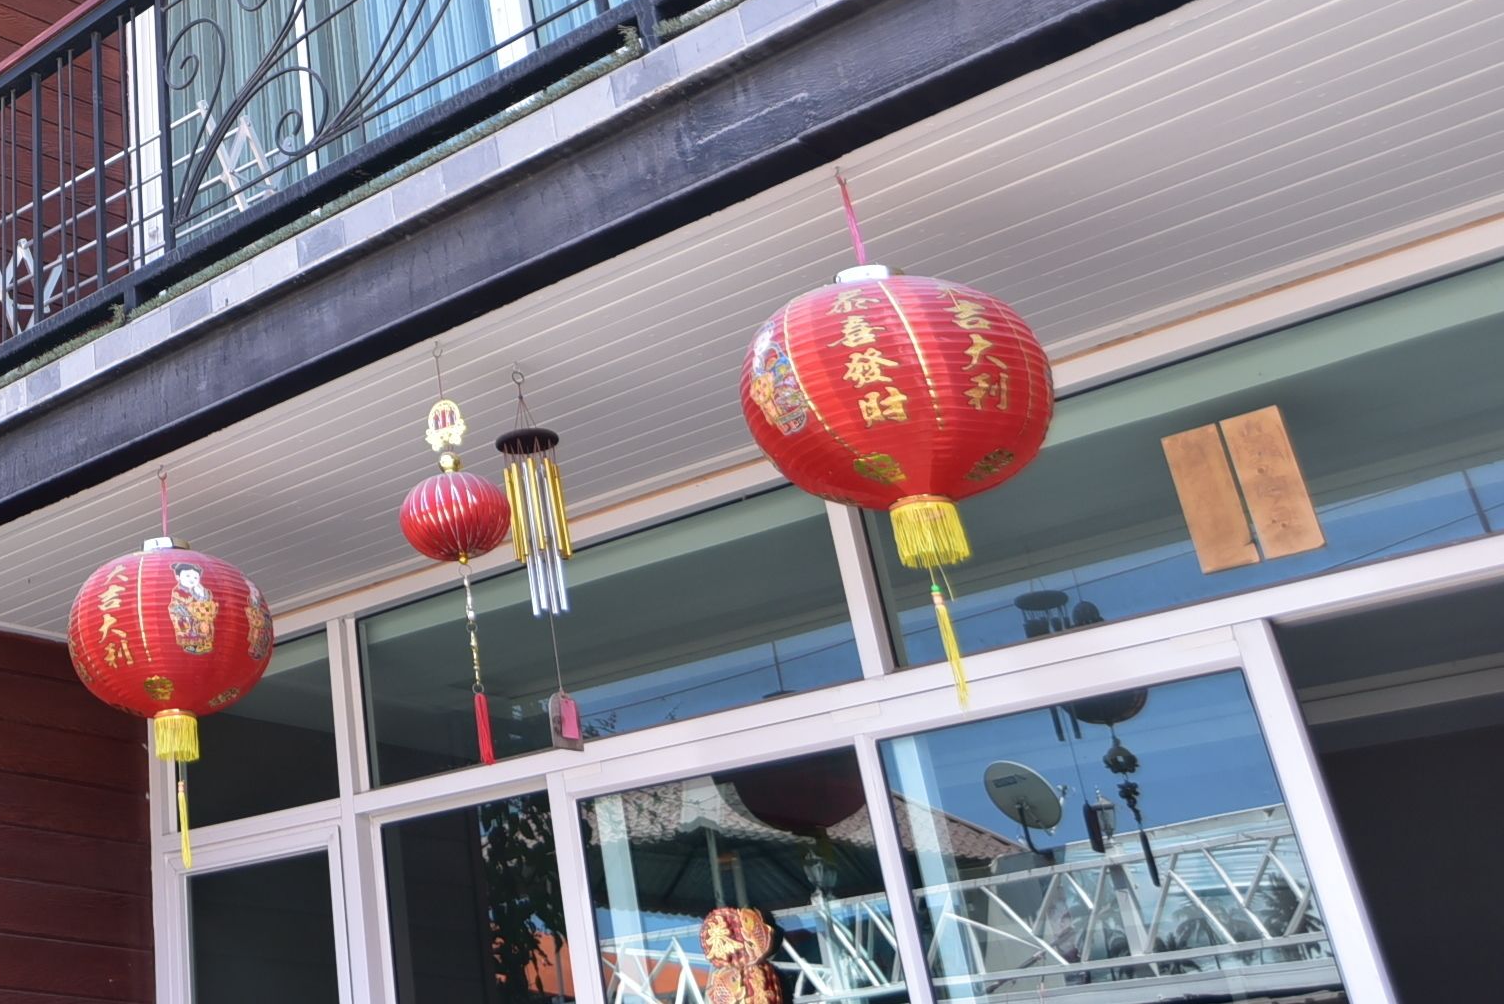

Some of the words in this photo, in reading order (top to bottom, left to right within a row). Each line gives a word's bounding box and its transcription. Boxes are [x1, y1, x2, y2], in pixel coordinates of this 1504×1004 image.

[825, 288, 908, 428] 恭喜發財
[97, 564, 134, 669] 大吉大利
